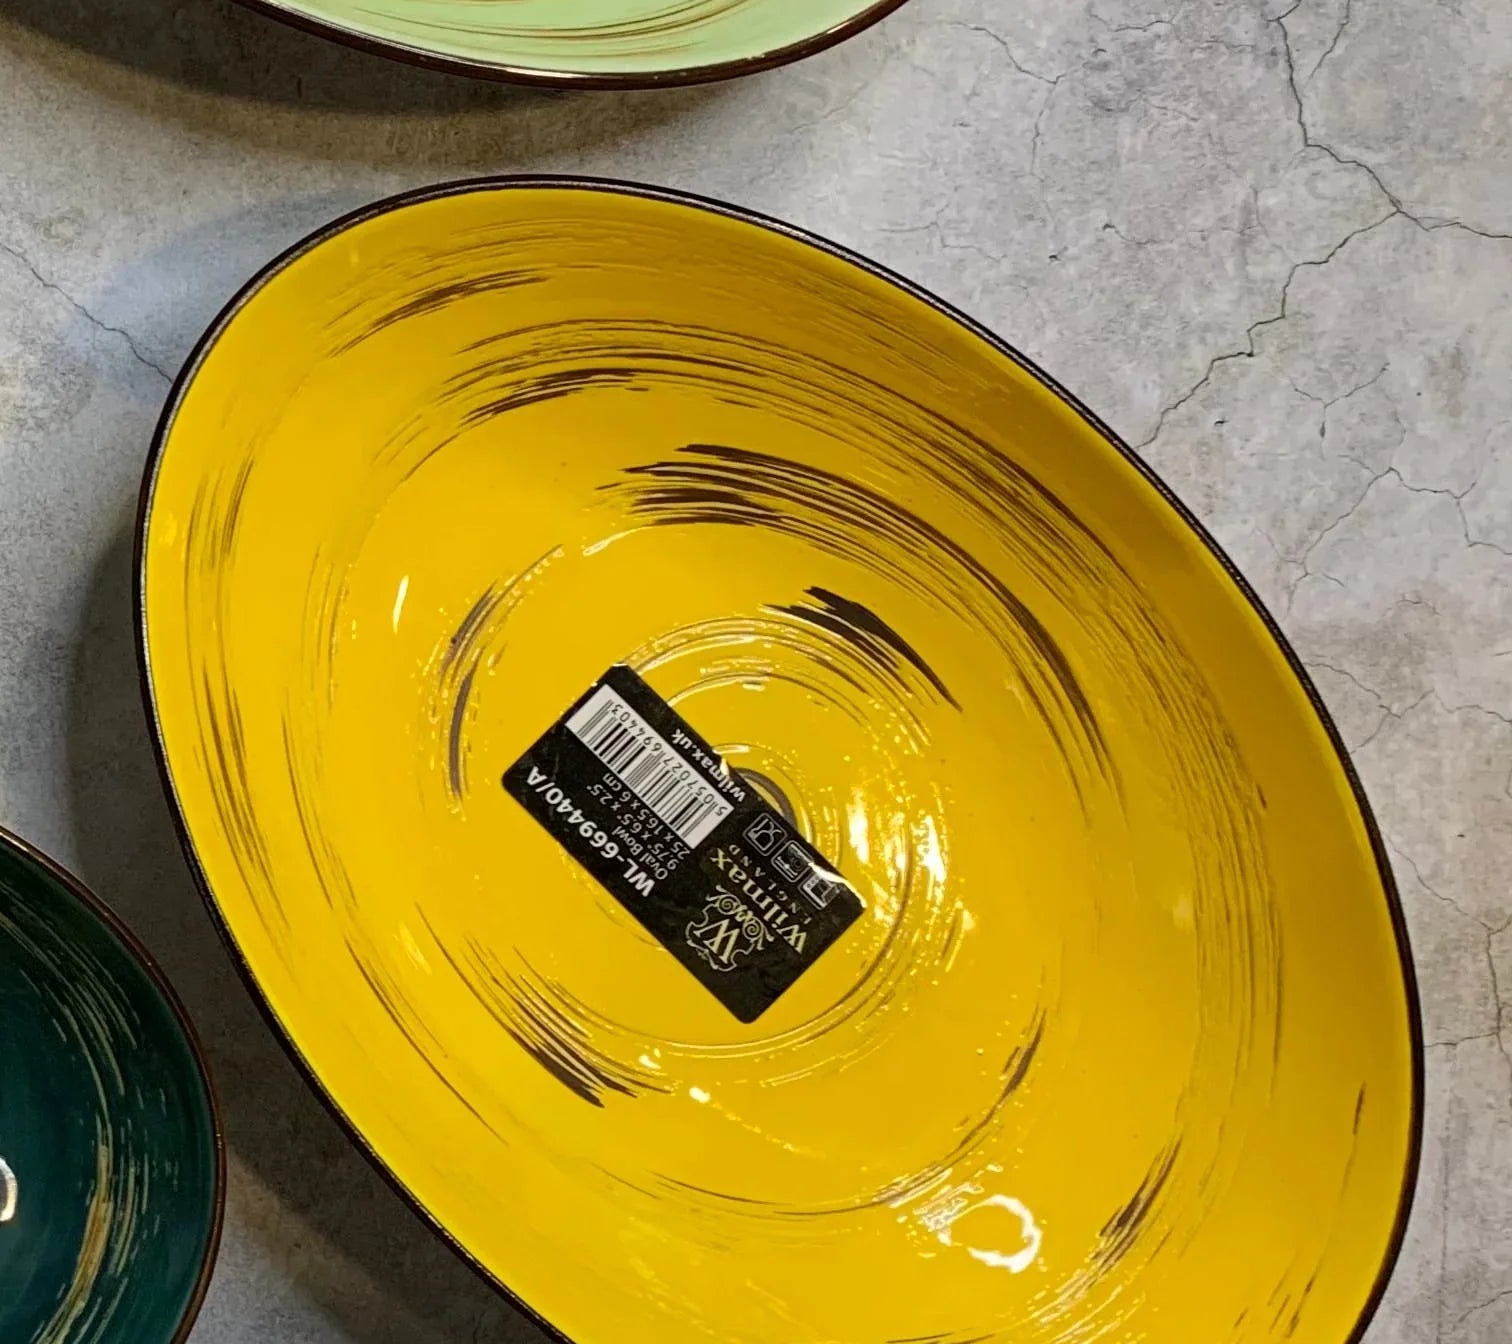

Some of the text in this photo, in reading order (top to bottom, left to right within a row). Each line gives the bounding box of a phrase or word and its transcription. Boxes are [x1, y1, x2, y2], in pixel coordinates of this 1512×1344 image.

[611, 703, 727, 816] 5 057027 694403
[671, 728, 745, 801] wilmax.uk
[526, 765, 655, 896] WL-669440/A
[602, 772, 690, 859] 25 x 16.5 x 6 cm
[610, 799, 621, 810] x
[640, 829, 651, 840] x
[611, 825, 667, 879] Oval Bowl
[728, 844, 811, 924] ENGLAND
[710, 847, 806, 953] Wilmax
